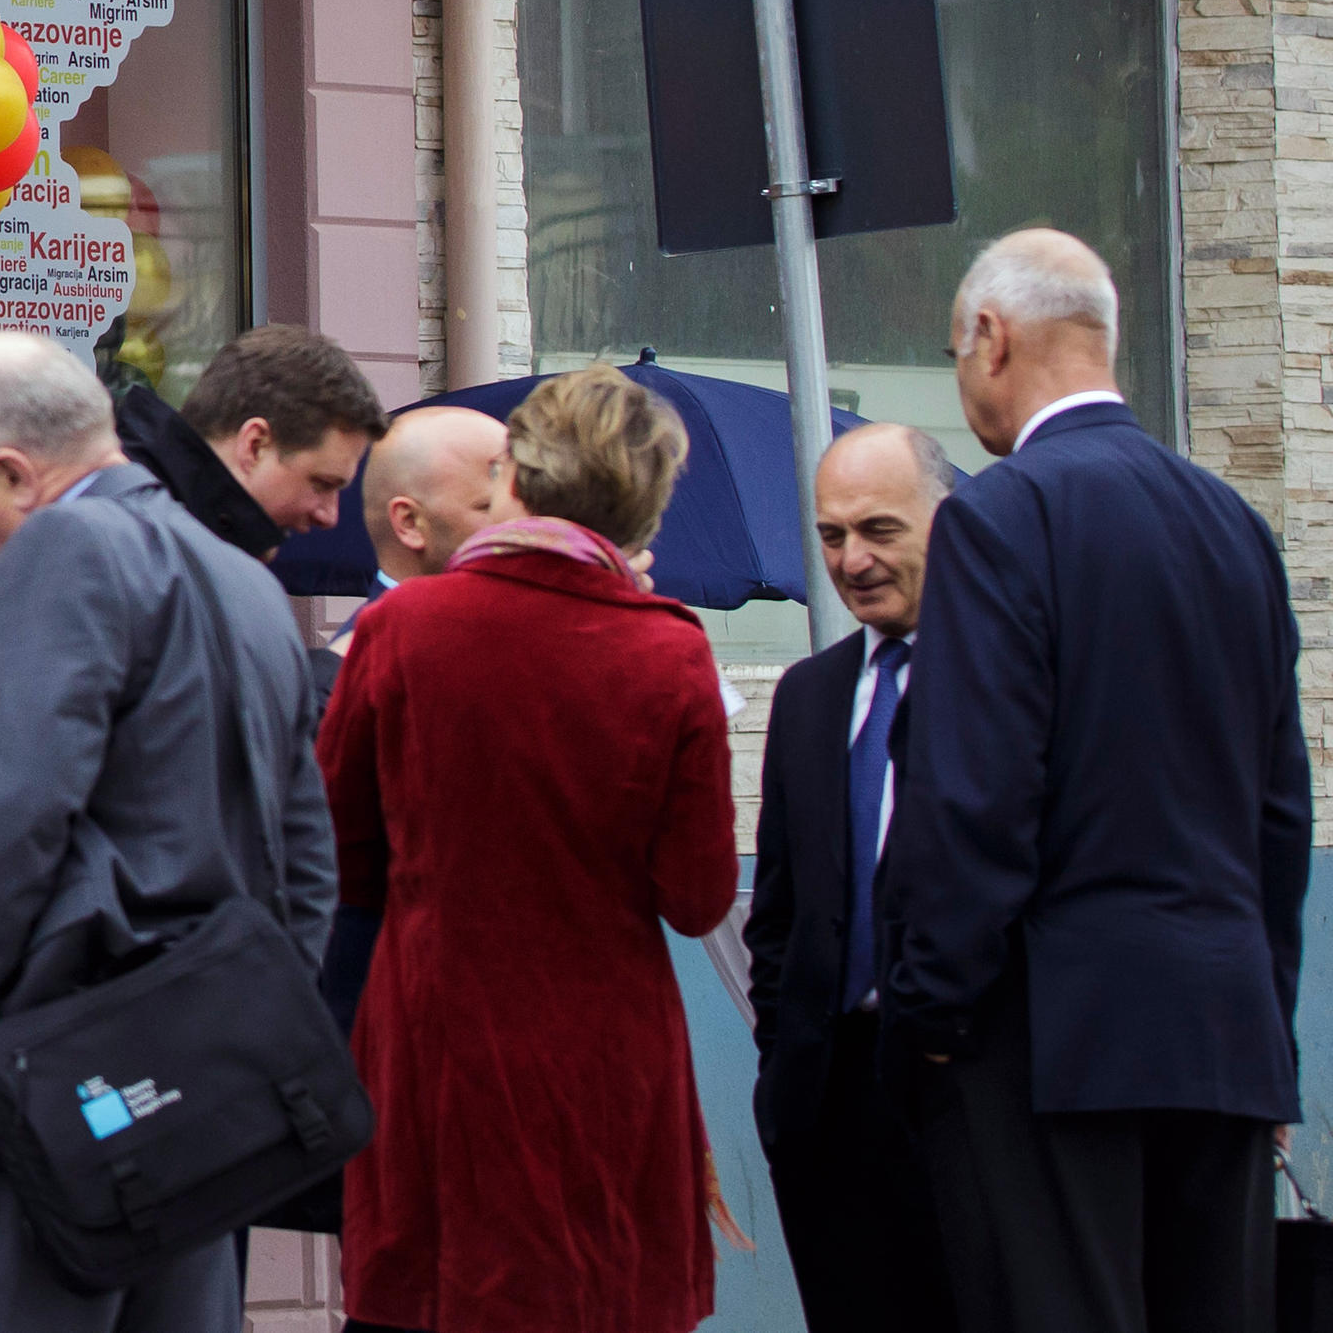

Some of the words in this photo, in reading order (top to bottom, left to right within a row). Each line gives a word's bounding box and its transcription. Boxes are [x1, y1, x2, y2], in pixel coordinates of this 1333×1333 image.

[90, 3, 137, 24] Migrim
[35, 52, 59, 67] grim
[68, 51, 110, 69] Arsim
[39, 67, 87, 85] Career
[35, 87, 70, 103] ation
[5, 179, 70, 209] racija
[30, 231, 125, 268] Karijera
[47, 268, 83, 280] Migracija
[87, 266, 128, 283] Arsim
[53, 283, 123, 302] Ausbildung
[56, 327, 89, 339] Karijera
